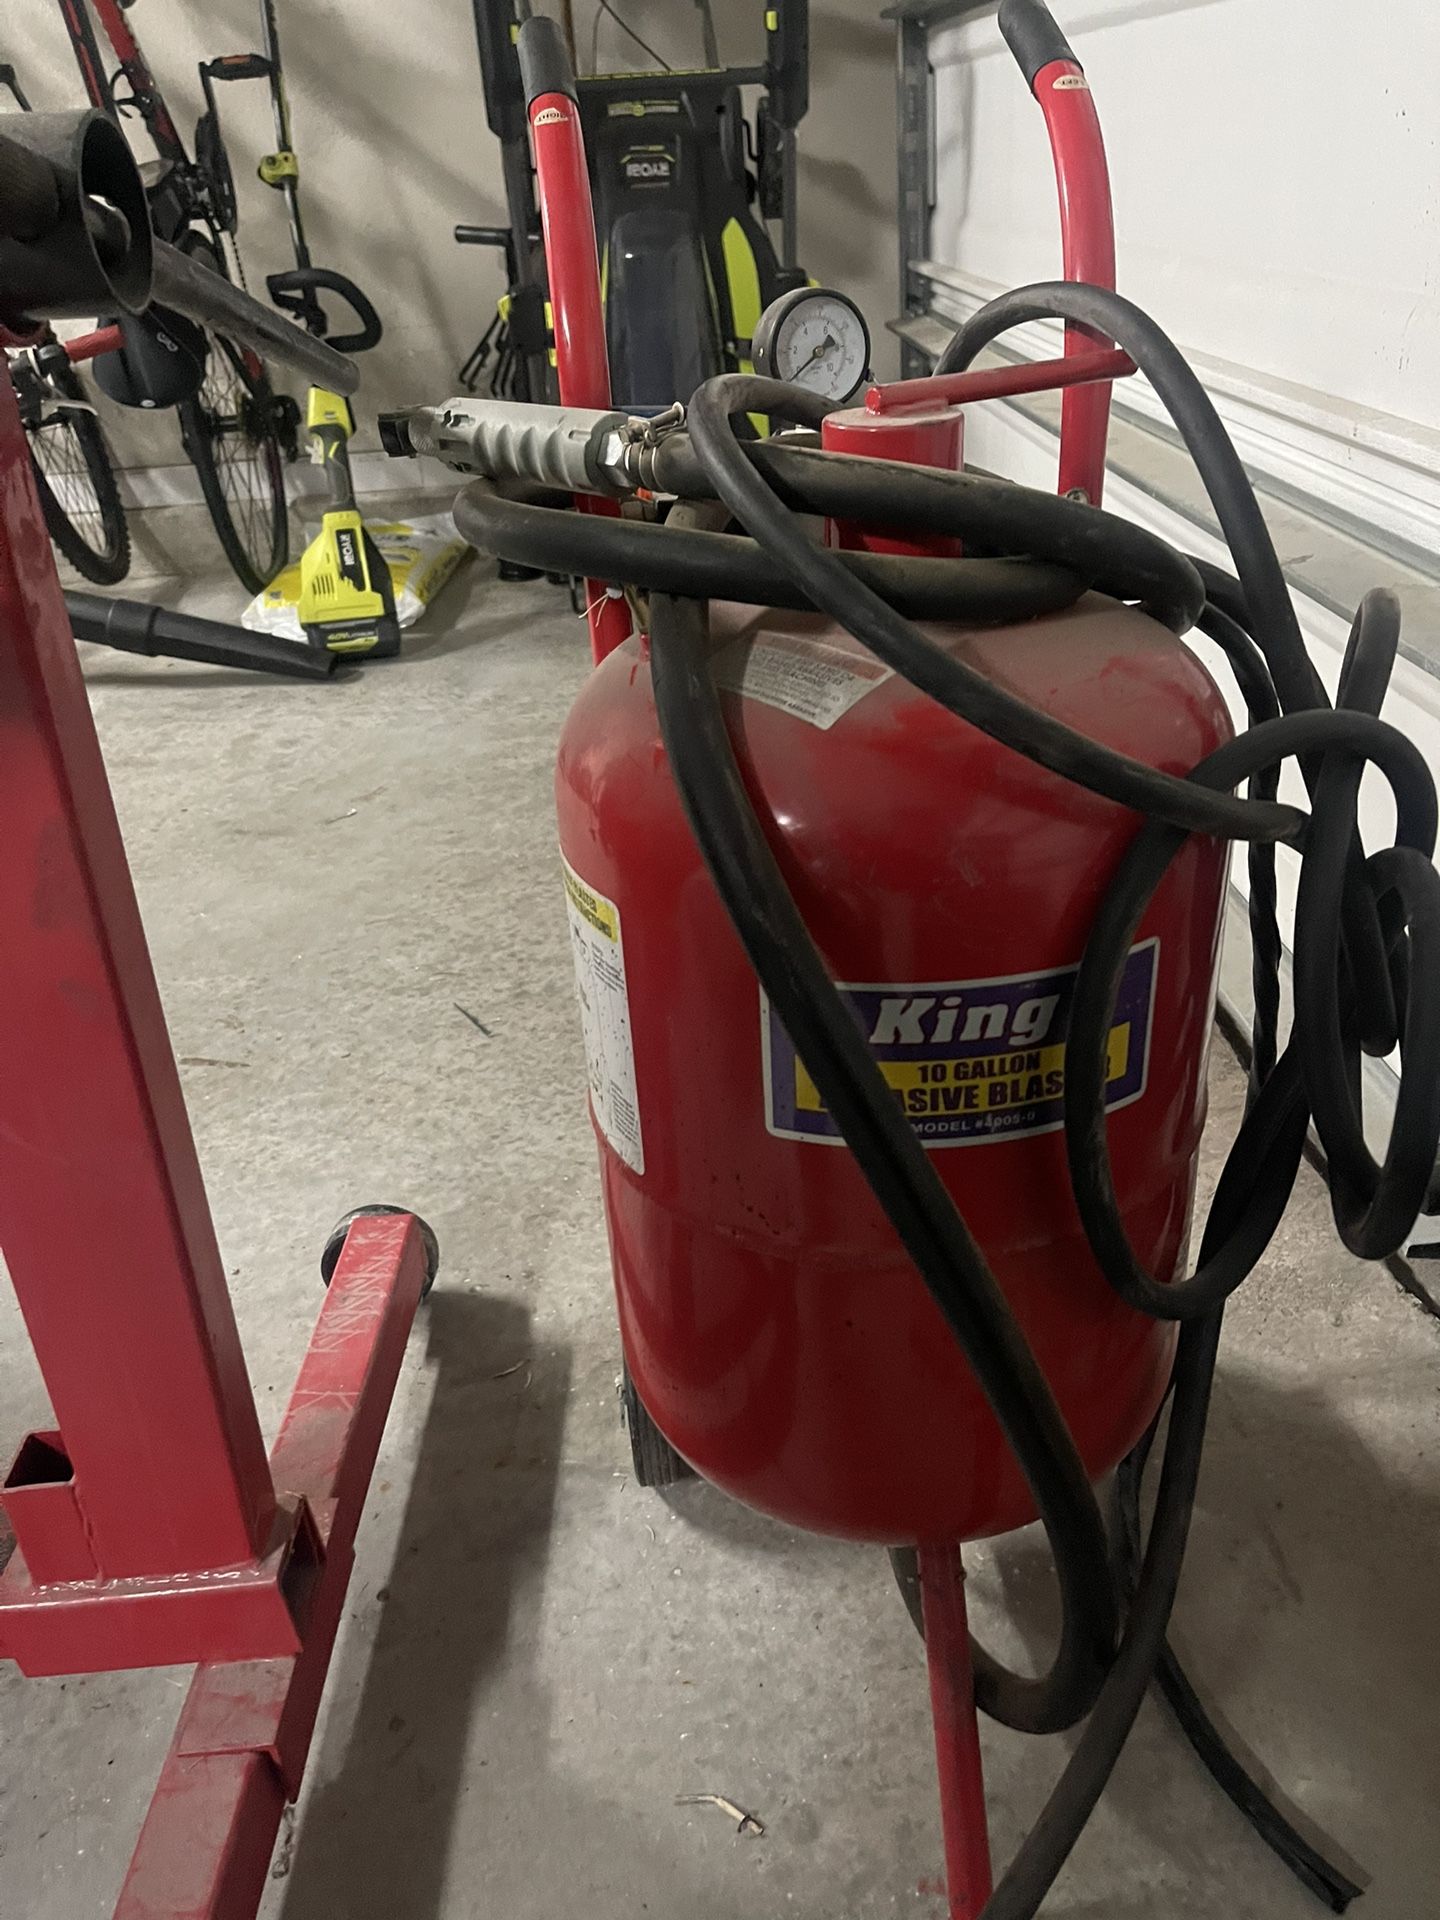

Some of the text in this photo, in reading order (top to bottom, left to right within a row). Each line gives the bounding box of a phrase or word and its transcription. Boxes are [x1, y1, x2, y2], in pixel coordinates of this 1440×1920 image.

[626, 161, 670, 177] RYOBI
[340, 533, 355, 566] RYOBI
[869, 994, 1060, 1046] King
[918, 1052, 1040, 1083] 10 GALLON
[910, 1120, 971, 1133] MODEL
